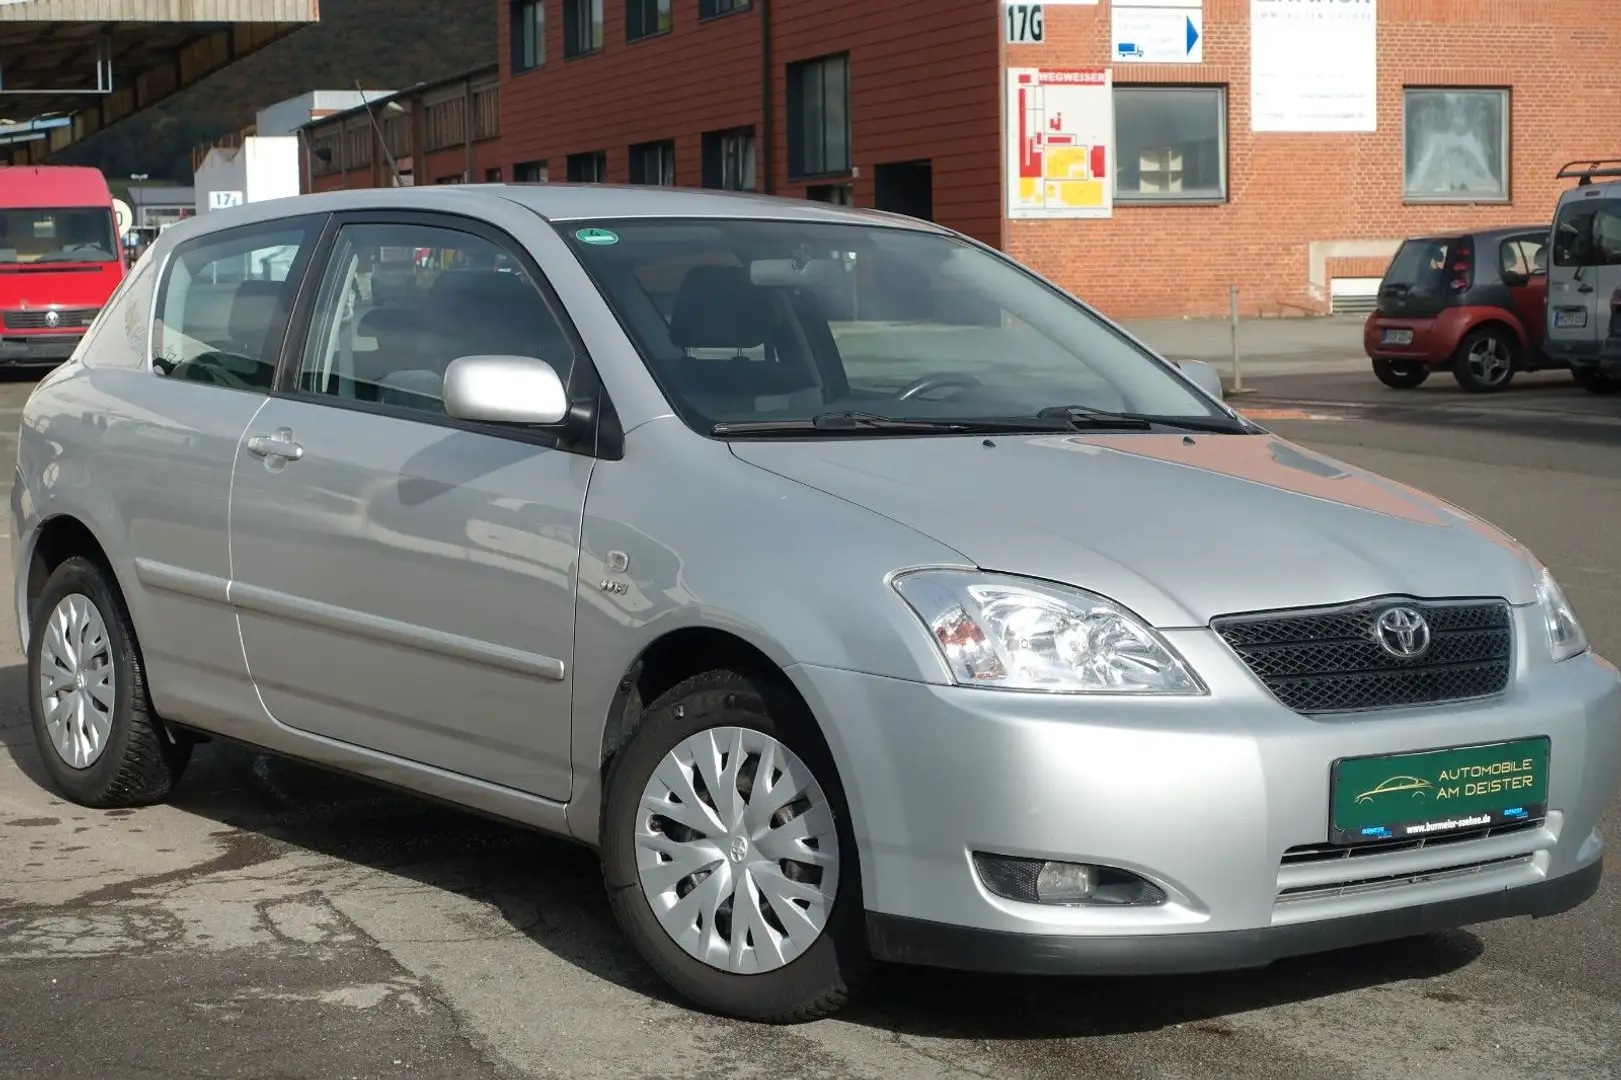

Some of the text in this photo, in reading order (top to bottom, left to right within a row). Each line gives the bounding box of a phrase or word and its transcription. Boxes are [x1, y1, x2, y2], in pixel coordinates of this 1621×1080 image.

[1008, 4, 1042, 41] 17G
[1039, 72, 1105, 82] WEGWEISER
[1438, 759, 1533, 782] AUTOMOBILE
[1436, 776, 1533, 800] AM DEISTER
